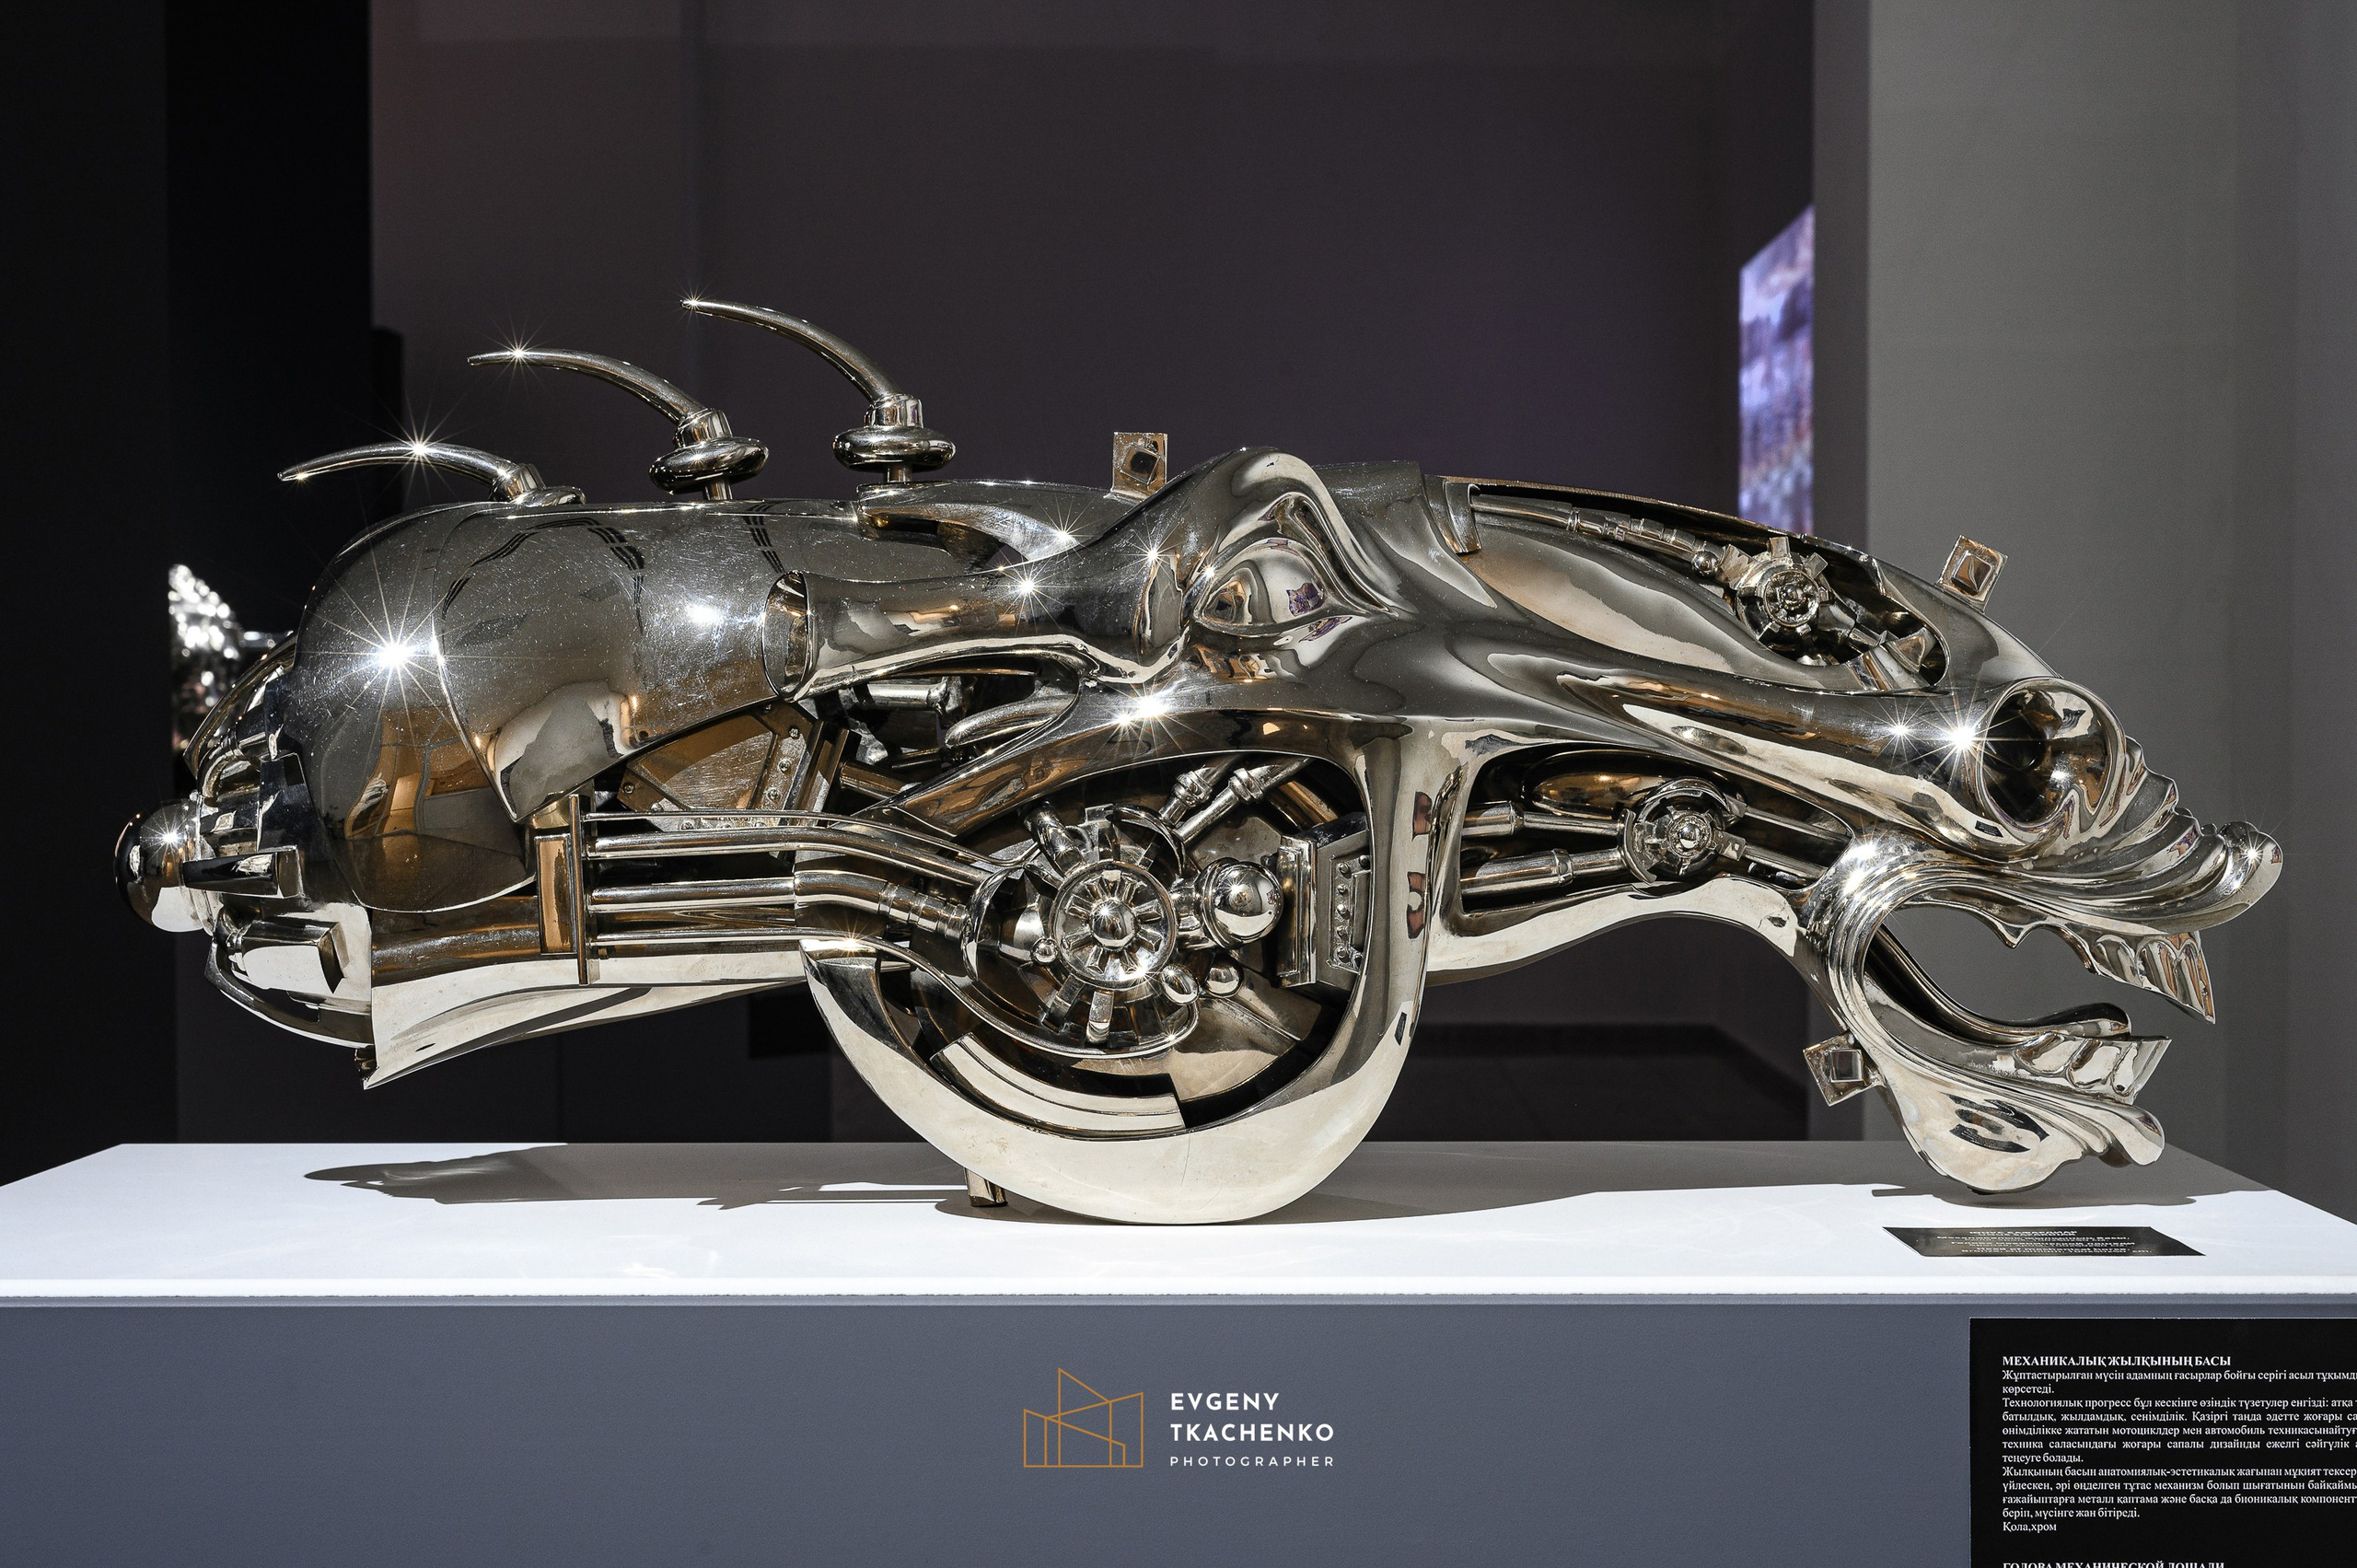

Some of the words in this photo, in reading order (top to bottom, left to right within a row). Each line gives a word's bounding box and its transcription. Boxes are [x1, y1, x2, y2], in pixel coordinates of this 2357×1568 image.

[2003, 1355, 2107, 1367] МЕХАНИКАЛЫҚ
[2108, 1355, 2193, 1368] ЖЫЛҚЫНЫҢ
[2195, 1355, 2231, 1365] БАСЫ
[2003, 1369, 2093, 1382] Жұптастырылған
[2096, 1369, 2124, 1382] мүсін
[2127, 1372, 2172, 1380] адамның
[2175, 1372, 2222, 1382] ғасырлар
[2223, 1369, 2256, 1379] бойғы
[2258, 1369, 2286, 1382] серігі
[2316, 1372, 2357, 1382] тұқымд
[2003, 1383, 2054, 1396] көрсетеді.
[2003, 1397, 2083, 1408] Технологиялық
[2085, 1400, 2131, 1410] прогресс
[2134, 1397, 2152, 1410] бұл
[2155, 1397, 2198, 1407] кескінге
[2200, 1397, 2236, 1408] өзіндік
[2238, 1400, 2288, 1410] түзетулер
[2291, 1397, 2328, 1408] енгізді:
[2331, 1399, 2352, 1408] атқа
[2003, 1411, 2056, 1422] батылдық,
[2061, 1413, 2126, 1422] жылдамдық,
[2131, 1411, 2187, 1422] сенімділік.
[2192, 1411, 2227, 1423] Қазіргі
[2267, 1413, 2299, 1422] әдетте
[2304, 1413, 2342, 1423] жоғары
[2003, 1424, 2061, 1435] өнімділікке
[2112, 1427, 2179, 1437] мотоциклдер
[2205, 1424, 2265, 1434] автомобиль
[2049, 1441, 2116, 1449] саласындағы
[2122, 1441, 2161, 1450] жоғары
[2210, 1438, 2259, 1448] дизайнды
[2266, 1438, 2299, 1448] ежелгі
[2305, 1437, 2350, 1450] сәйгүлік
[2003, 1455, 2041, 1465] теңеуге
[2043, 1452, 2084, 1463] болады.
[2003, 1466, 2063, 1477] Жылқының
[2065, 1466, 2097, 1476] басын
[2098, 1468, 2235, 1477] анатомиялық-эстетикалық
[2283, 1468, 2321, 1478] мұқият
[2003, 1480, 2052, 1493] үйлескен,
[2056, 1480, 2070, 1492] әрі
[2123, 1481, 2151, 1492] тұтас
[2154, 1481, 2203, 1490] механизм
[2207, 1480, 2239, 1490] болып
[2003, 1493, 2075, 1505] ғажайыптарға
[2078, 1495, 2114, 1504] металл
[2118, 1495, 2158, 1504] қаптама
[2161, 1495, 2187, 1504] және
[2189, 1493, 2217, 1504] басқа
[2220, 1495, 2232, 1504] да
[2235, 1493, 2298, 1504] бионикалық
[2003, 1507, 2033, 1519] беріп,
[2035, 1506, 2074, 1519] мүсінге
[2076, 1509, 2096, 1517] жан
[2098, 1506, 2140, 1519] бітіреді.
[2003, 1521, 2056, 1533] Қола,хром
